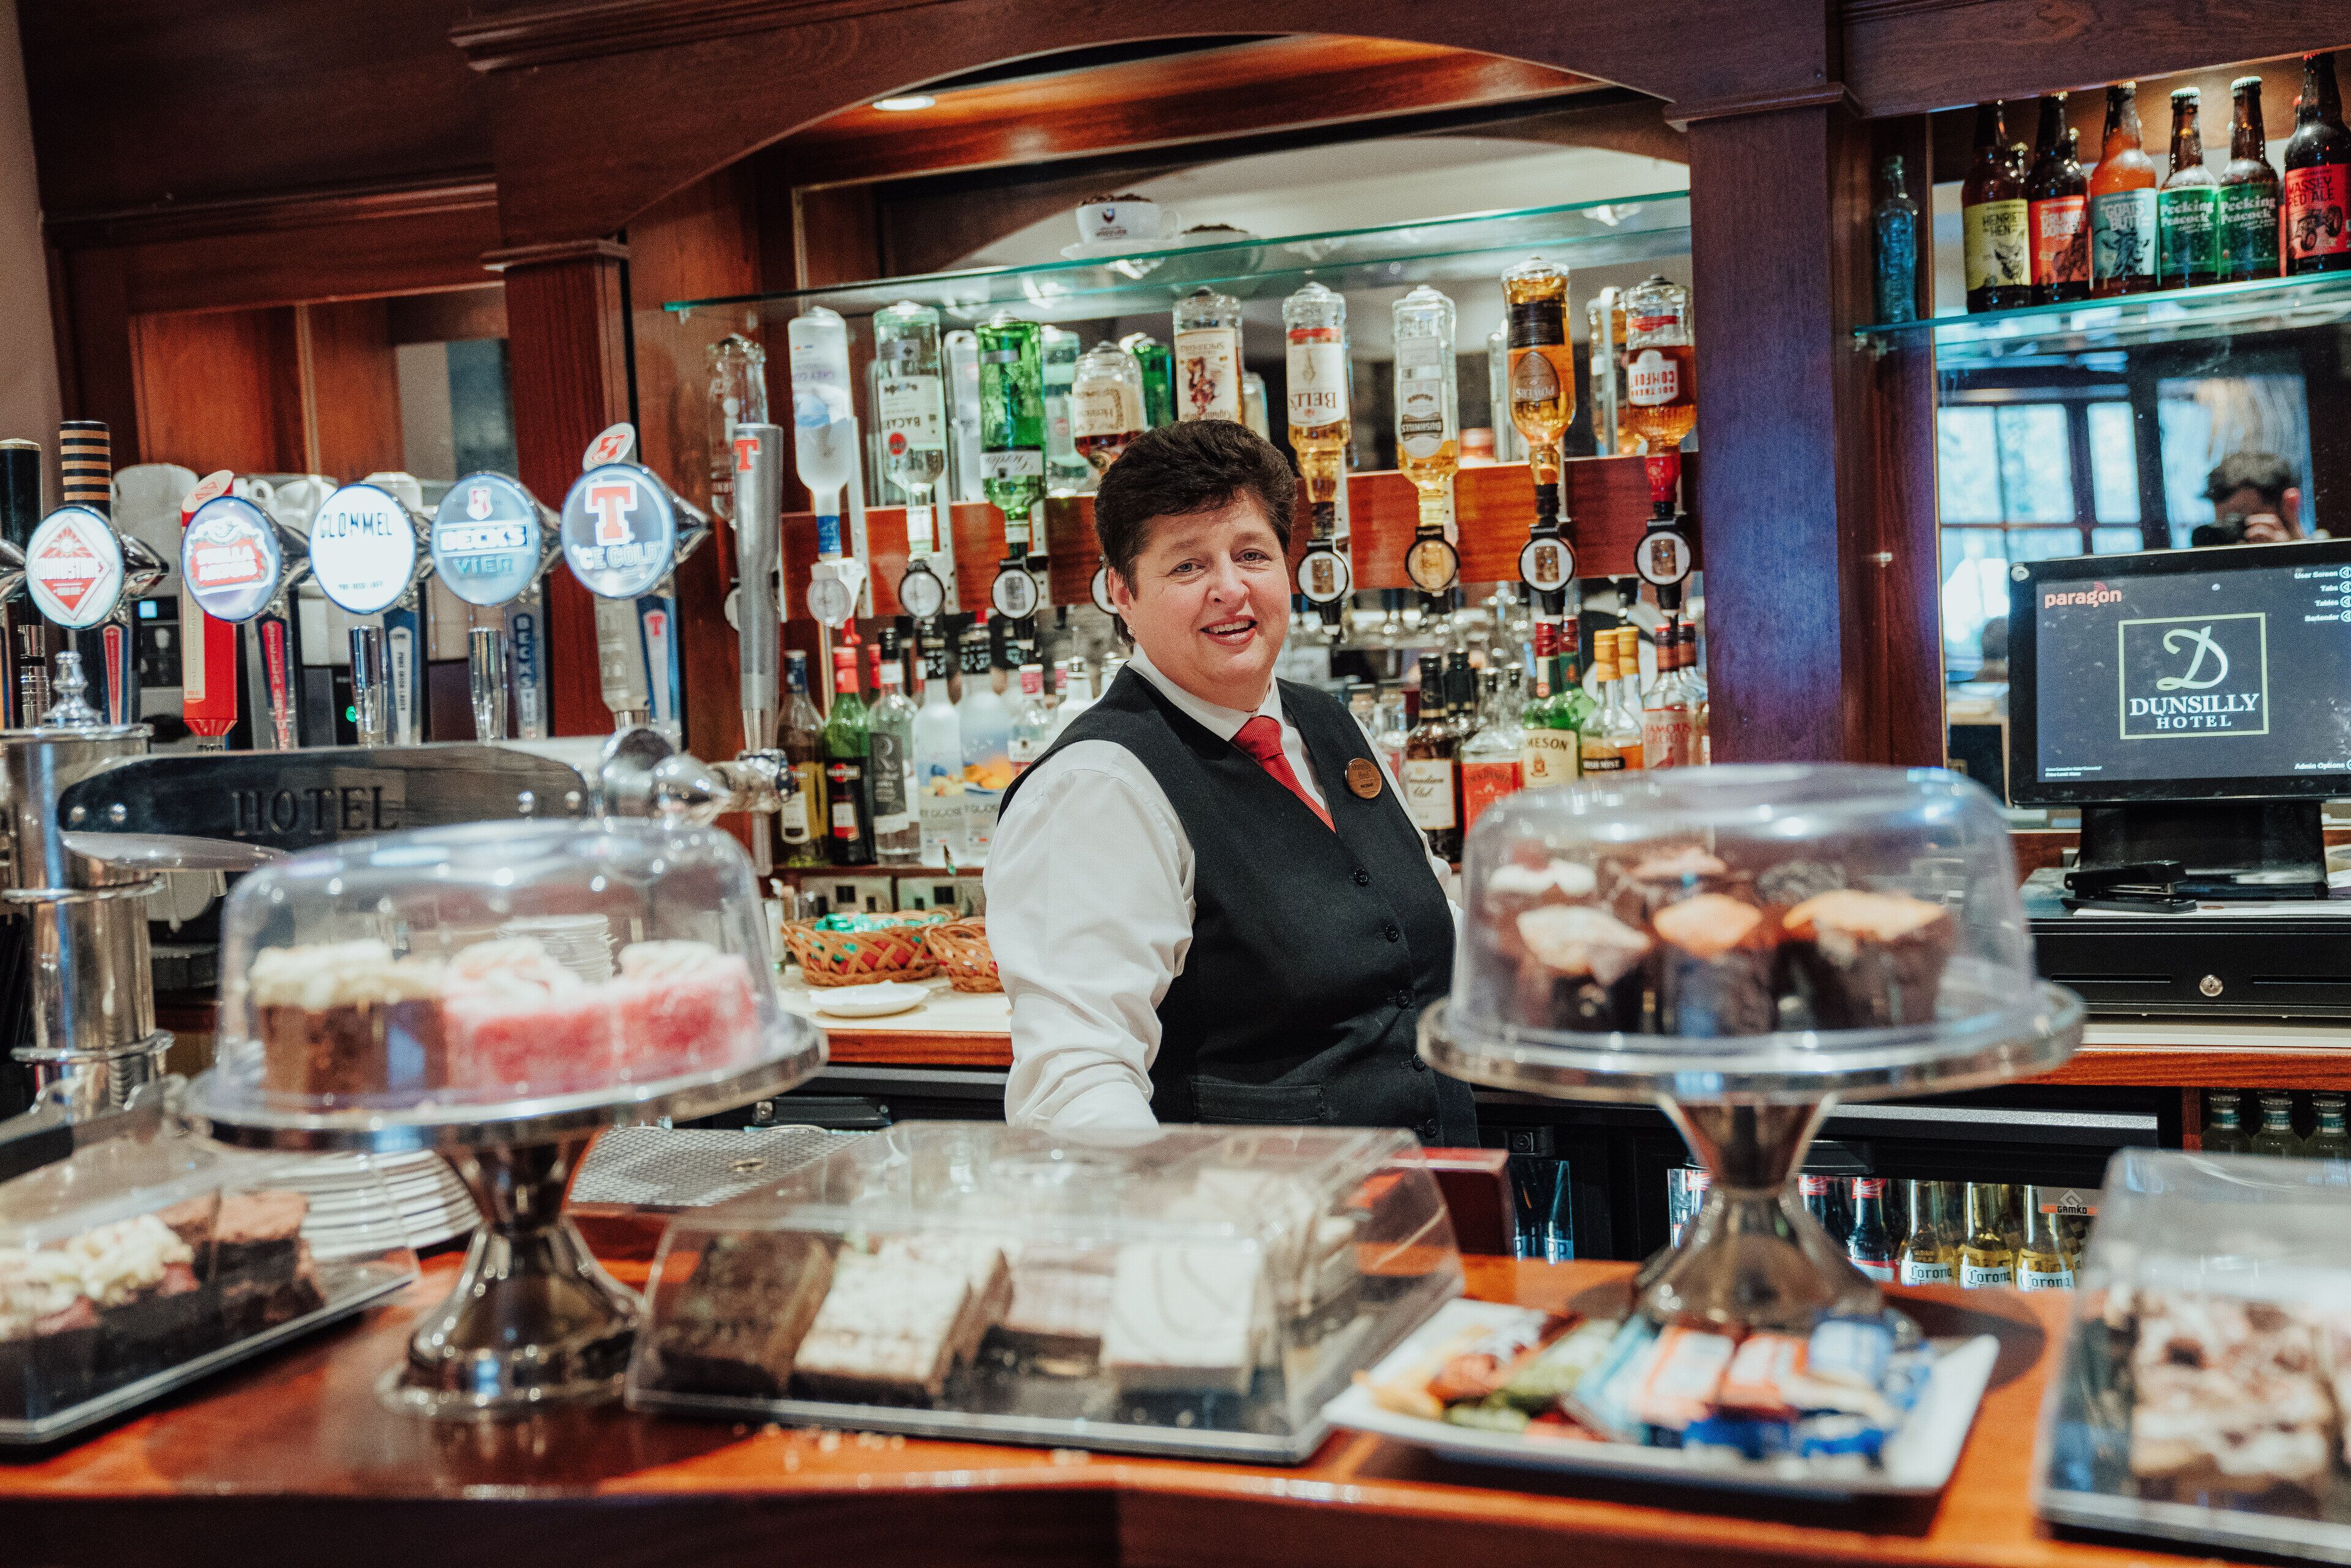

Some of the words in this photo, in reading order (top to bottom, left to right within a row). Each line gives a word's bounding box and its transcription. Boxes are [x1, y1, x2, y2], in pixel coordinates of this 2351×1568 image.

[2311, 187, 2334, 203] ALE
[2160, 199, 2214, 216] Pecking
[2221, 195, 2276, 214] Pecking
[2161, 211, 2210, 227] Peacock
[2221, 209, 2271, 225] Peacock
[1990, 224, 2011, 236] HEN
[733, 438, 759, 471] T
[589, 484, 634, 541] T
[452, 555, 513, 576] VIER
[2044, 589, 2123, 609] paragon
[648, 615, 663, 637] T
[2155, 625, 2229, 691] D
[2128, 692, 2260, 716] DUNSILLY
[2155, 715, 2232, 730] HOTEL
[2316, 762, 2346, 770] Options
[230, 786, 401, 836] HOTEL
[1910, 1264, 1953, 1280] Corona
[1968, 1267, 2011, 1285] Corona
[2021, 1272, 2070, 1288] Corona
